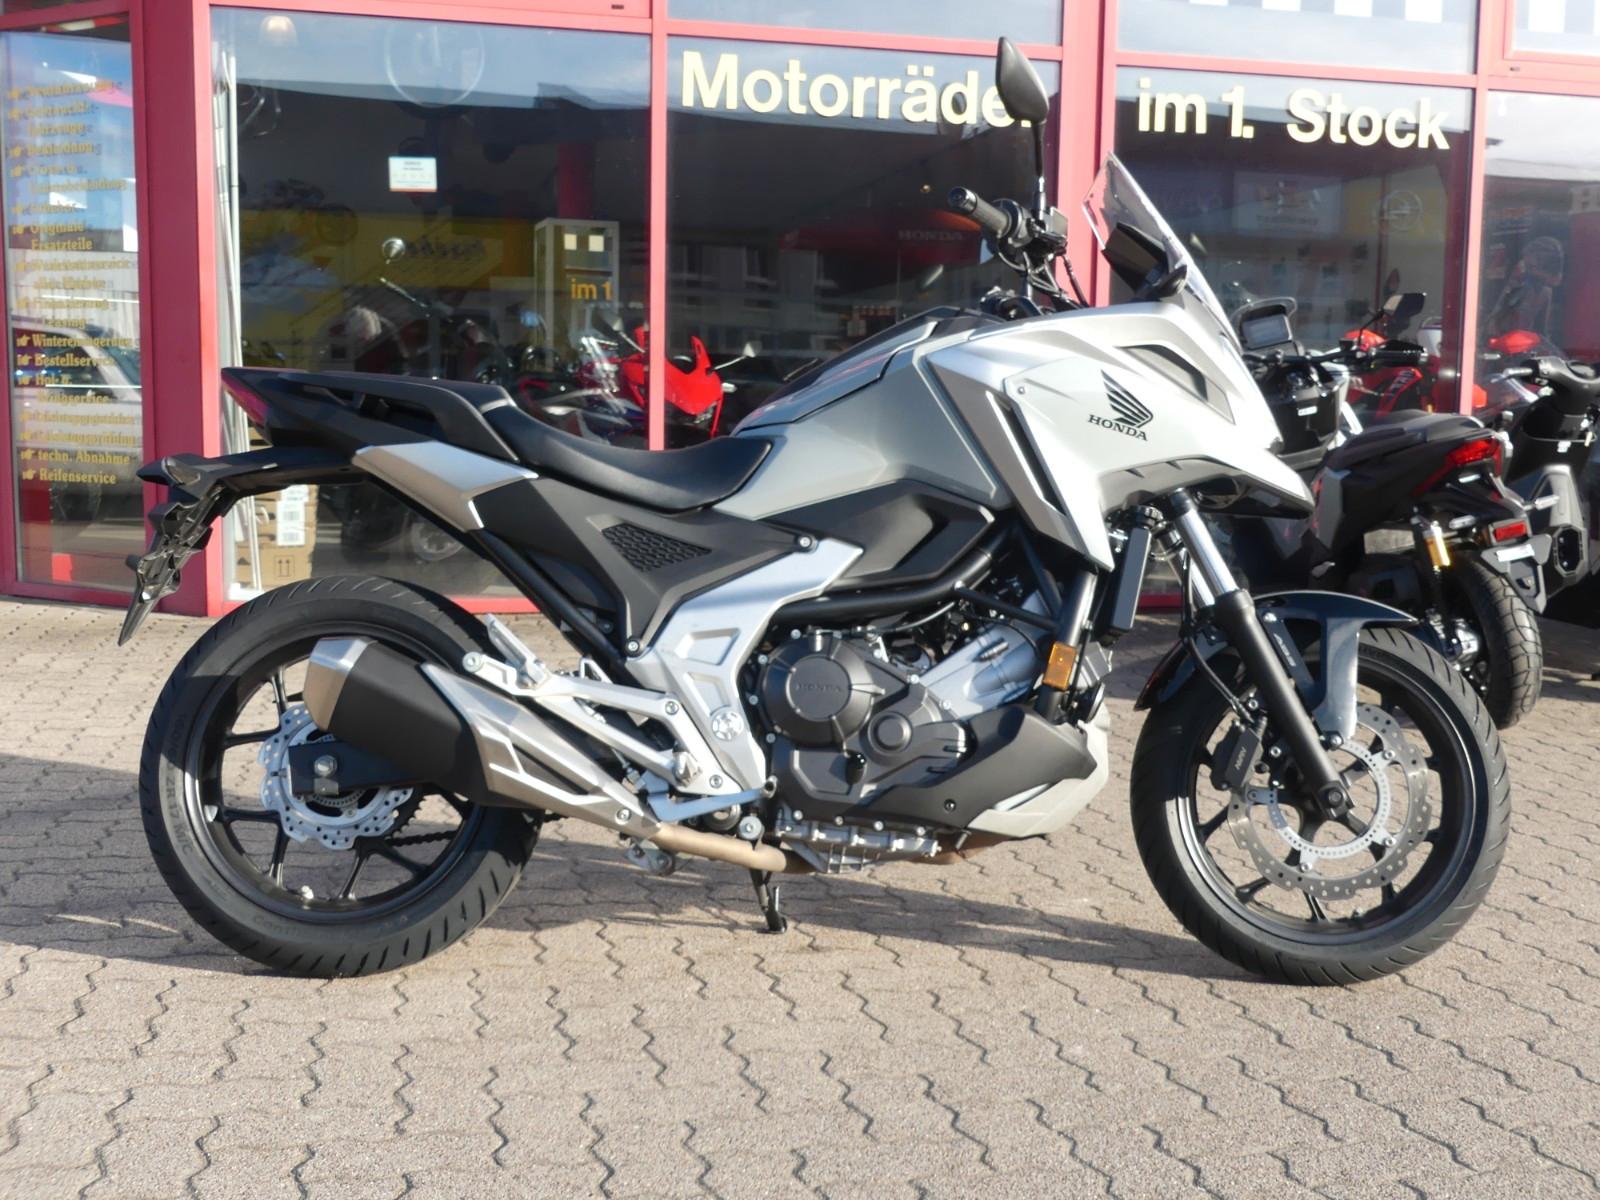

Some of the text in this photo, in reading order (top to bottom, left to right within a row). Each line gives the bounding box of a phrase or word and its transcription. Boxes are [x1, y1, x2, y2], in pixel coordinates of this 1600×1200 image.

[682, 51, 1031, 127] Motorräde
[1138, 78, 1450, 150] im 1. Stock
[571, 278, 597, 299] im
[35, 353, 116, 367] Bestellservice
[1087, 414, 1148, 441] HONDA
[76, 451, 131, 464] Abnahme
[40, 468, 117, 484] Reifenservice
